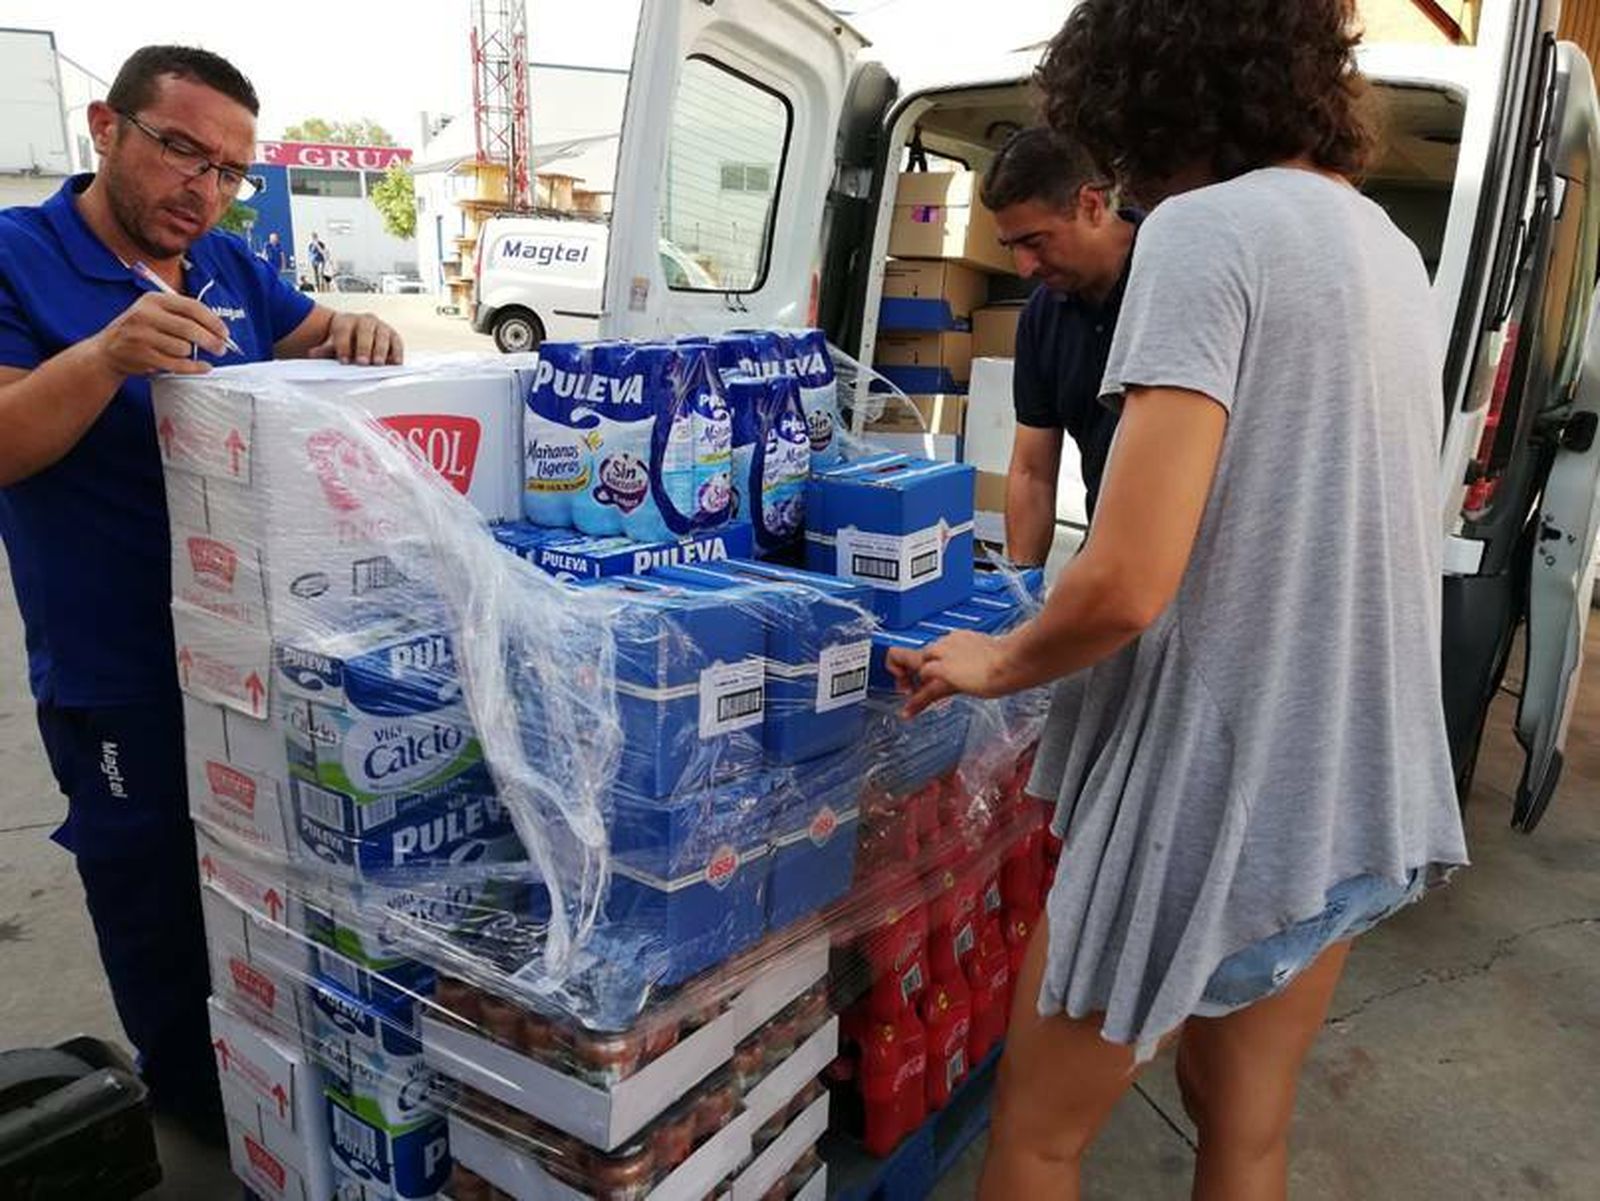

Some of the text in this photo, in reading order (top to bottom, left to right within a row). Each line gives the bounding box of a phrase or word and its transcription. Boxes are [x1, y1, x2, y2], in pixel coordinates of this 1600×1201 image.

[502, 240, 588, 265] Magtel
[532, 359, 644, 405] PULEVA
[612, 459, 637, 480] Sin
[540, 550, 588, 573] PULEVA
[634, 536, 729, 576] PULEVA
[100, 740, 129, 799] Magtel
[363, 723, 464, 780] Calcio
[391, 794, 508, 868] PULEV
